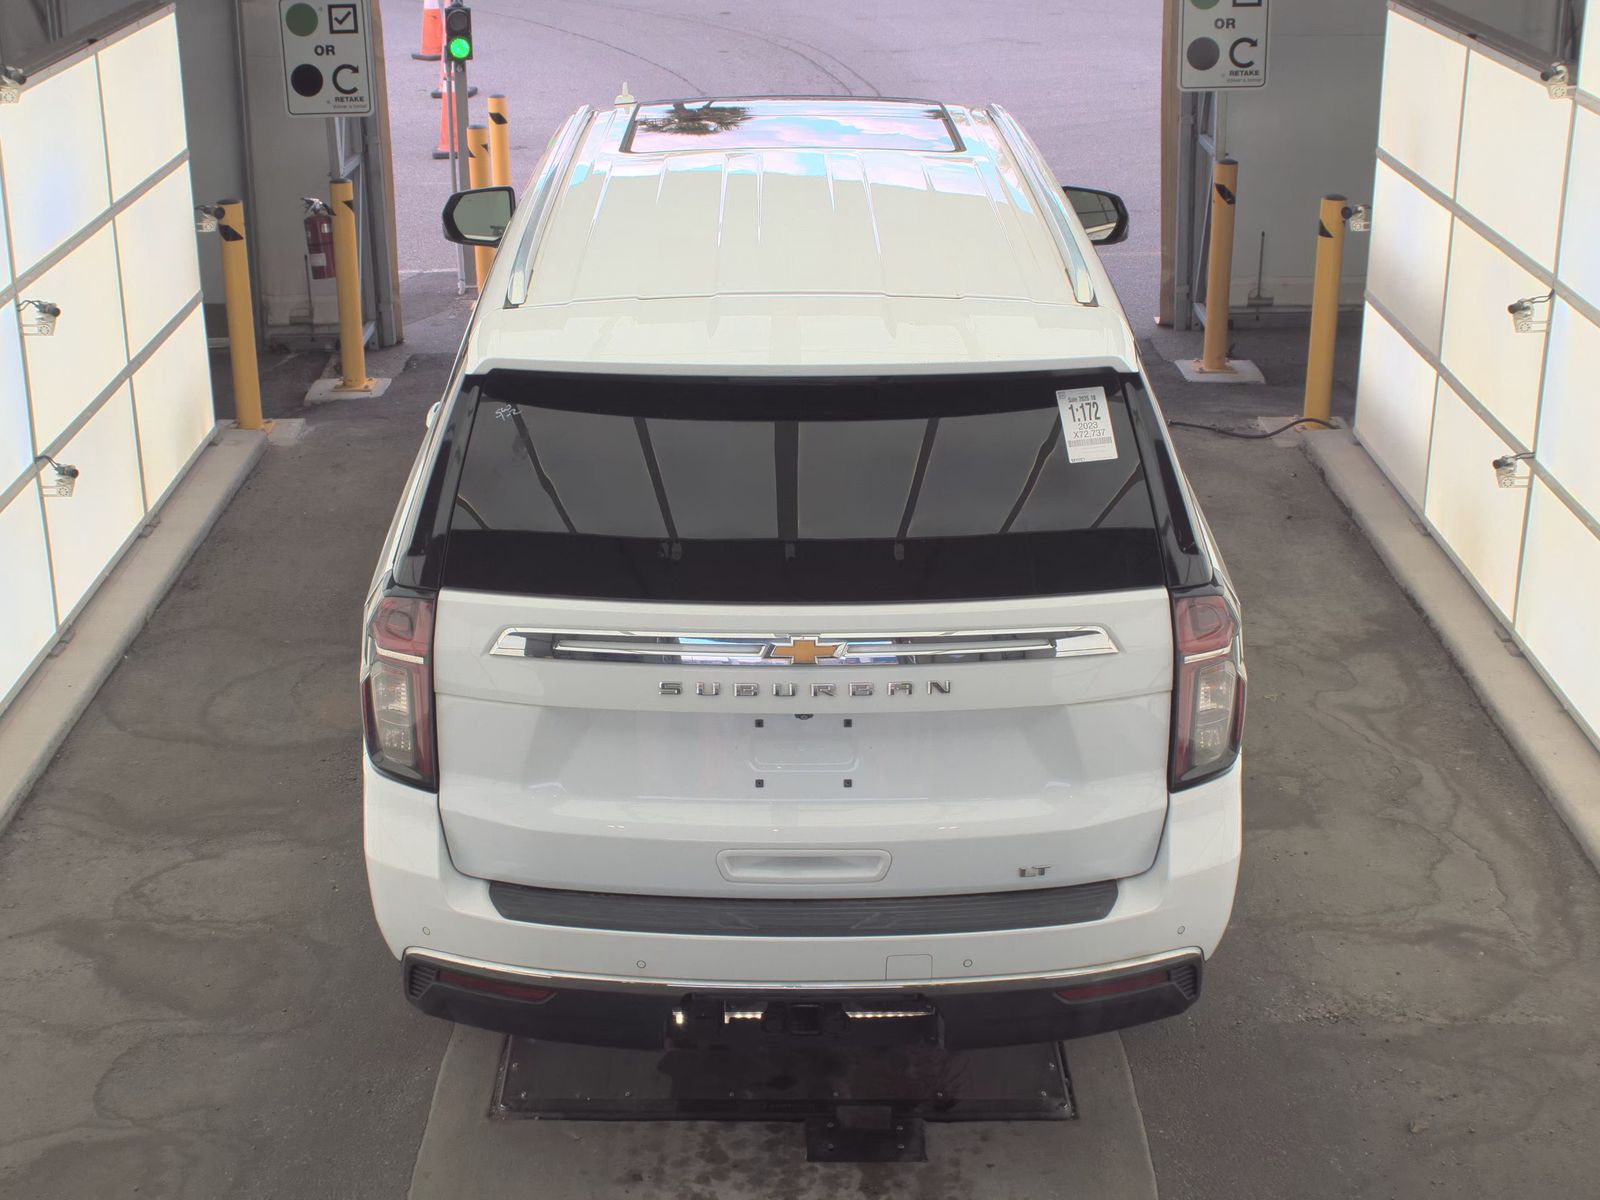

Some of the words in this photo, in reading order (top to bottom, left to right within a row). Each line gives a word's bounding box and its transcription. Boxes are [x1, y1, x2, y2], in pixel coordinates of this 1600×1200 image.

[1214, 18, 1236, 29] OR
[314, 45, 335, 56] OR
[1068, 401, 1101, 422] 1:172
[1078, 421, 1098, 430] 2023
[657, 679, 952, 698] SUBURBAN
[1018, 864, 1052, 877] LT
